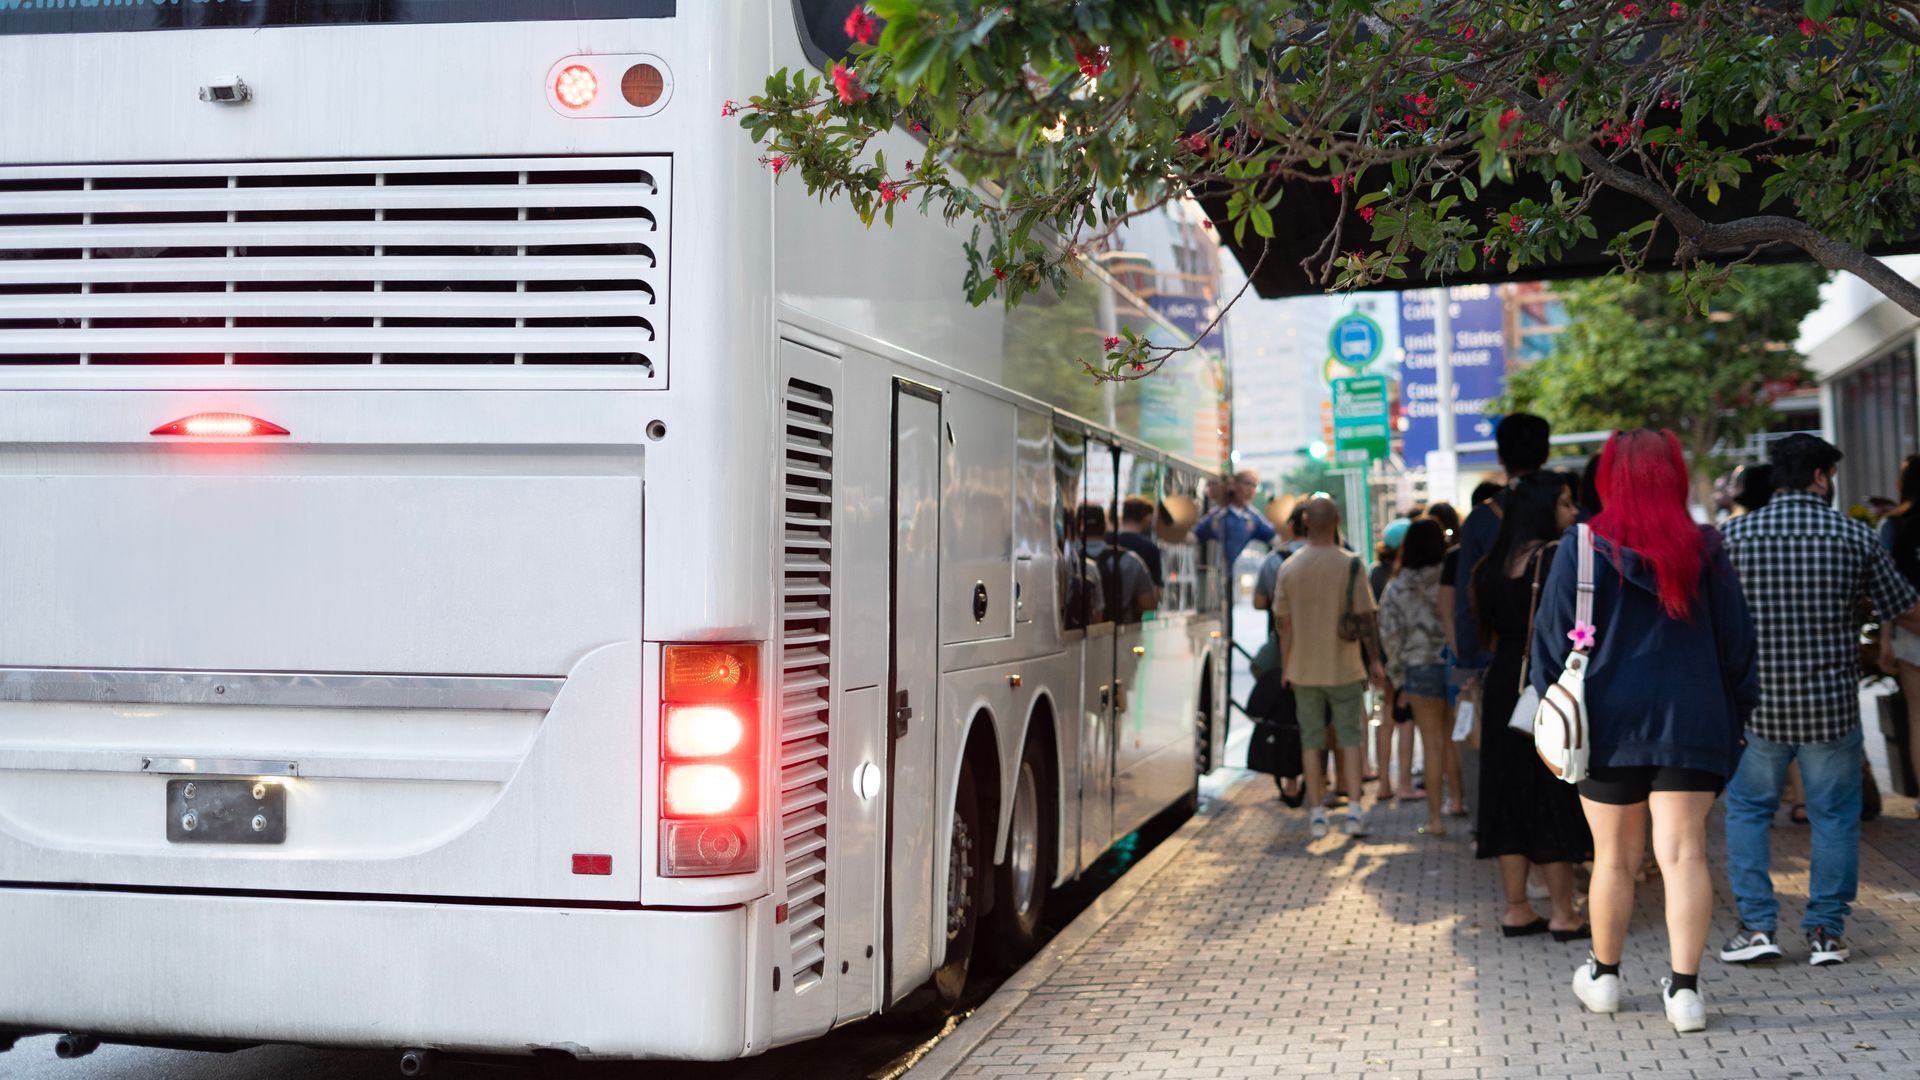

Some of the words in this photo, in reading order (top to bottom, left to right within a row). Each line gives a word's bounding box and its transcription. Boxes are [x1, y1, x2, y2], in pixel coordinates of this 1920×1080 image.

[1403, 303, 1461, 320] Collee
[1404, 333, 1452, 350] Unite
[1456, 331, 1504, 348] States
